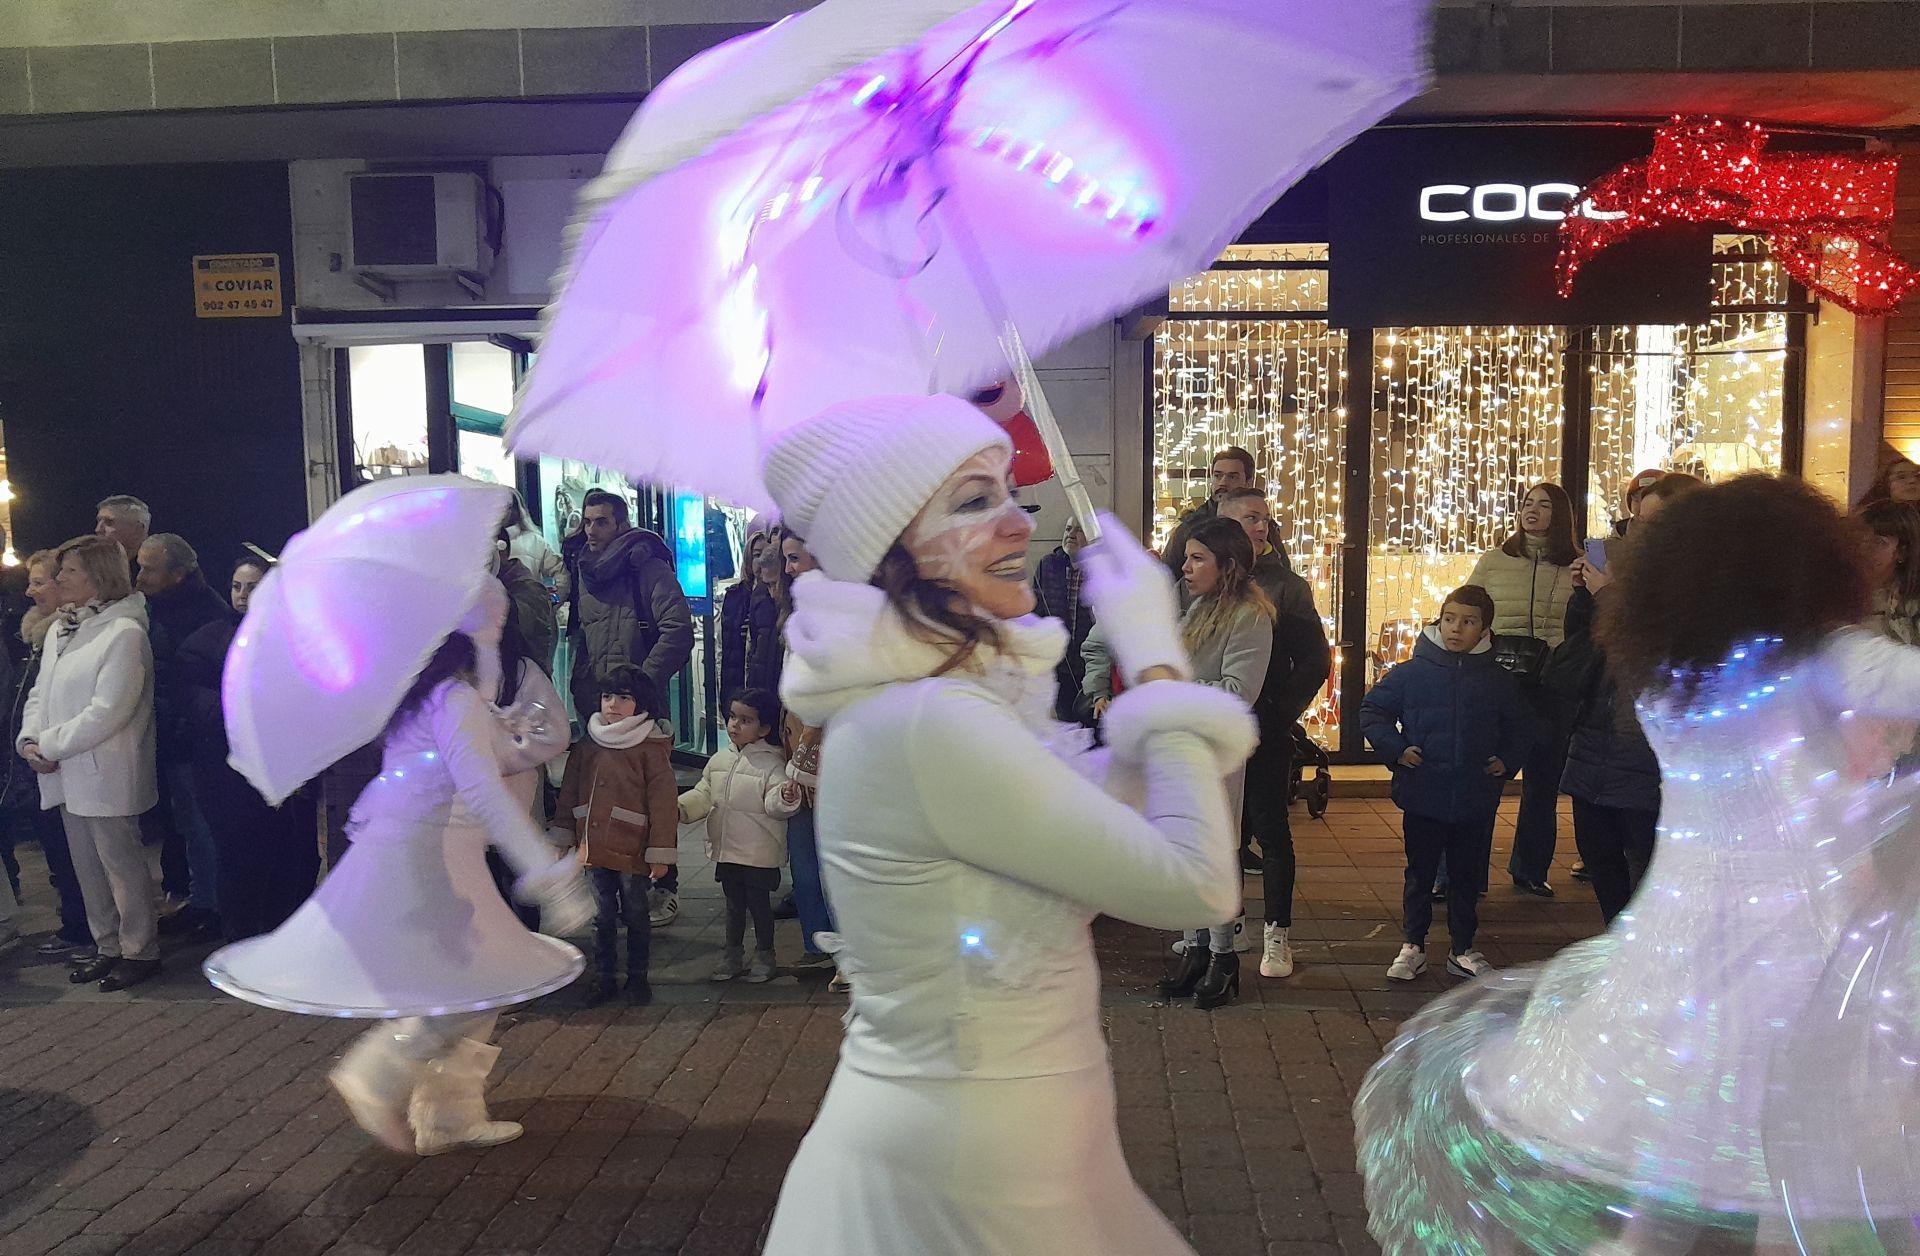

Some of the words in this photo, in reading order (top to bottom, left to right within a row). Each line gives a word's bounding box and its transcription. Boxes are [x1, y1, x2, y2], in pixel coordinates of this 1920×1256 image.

[1419, 233, 1527, 245] PROFESIONALES
[1533, 233, 1549, 244] DE
[215, 279, 273, 291] COVIAR
[203, 300, 224, 310] 902
[260, 298, 273, 308] 47
